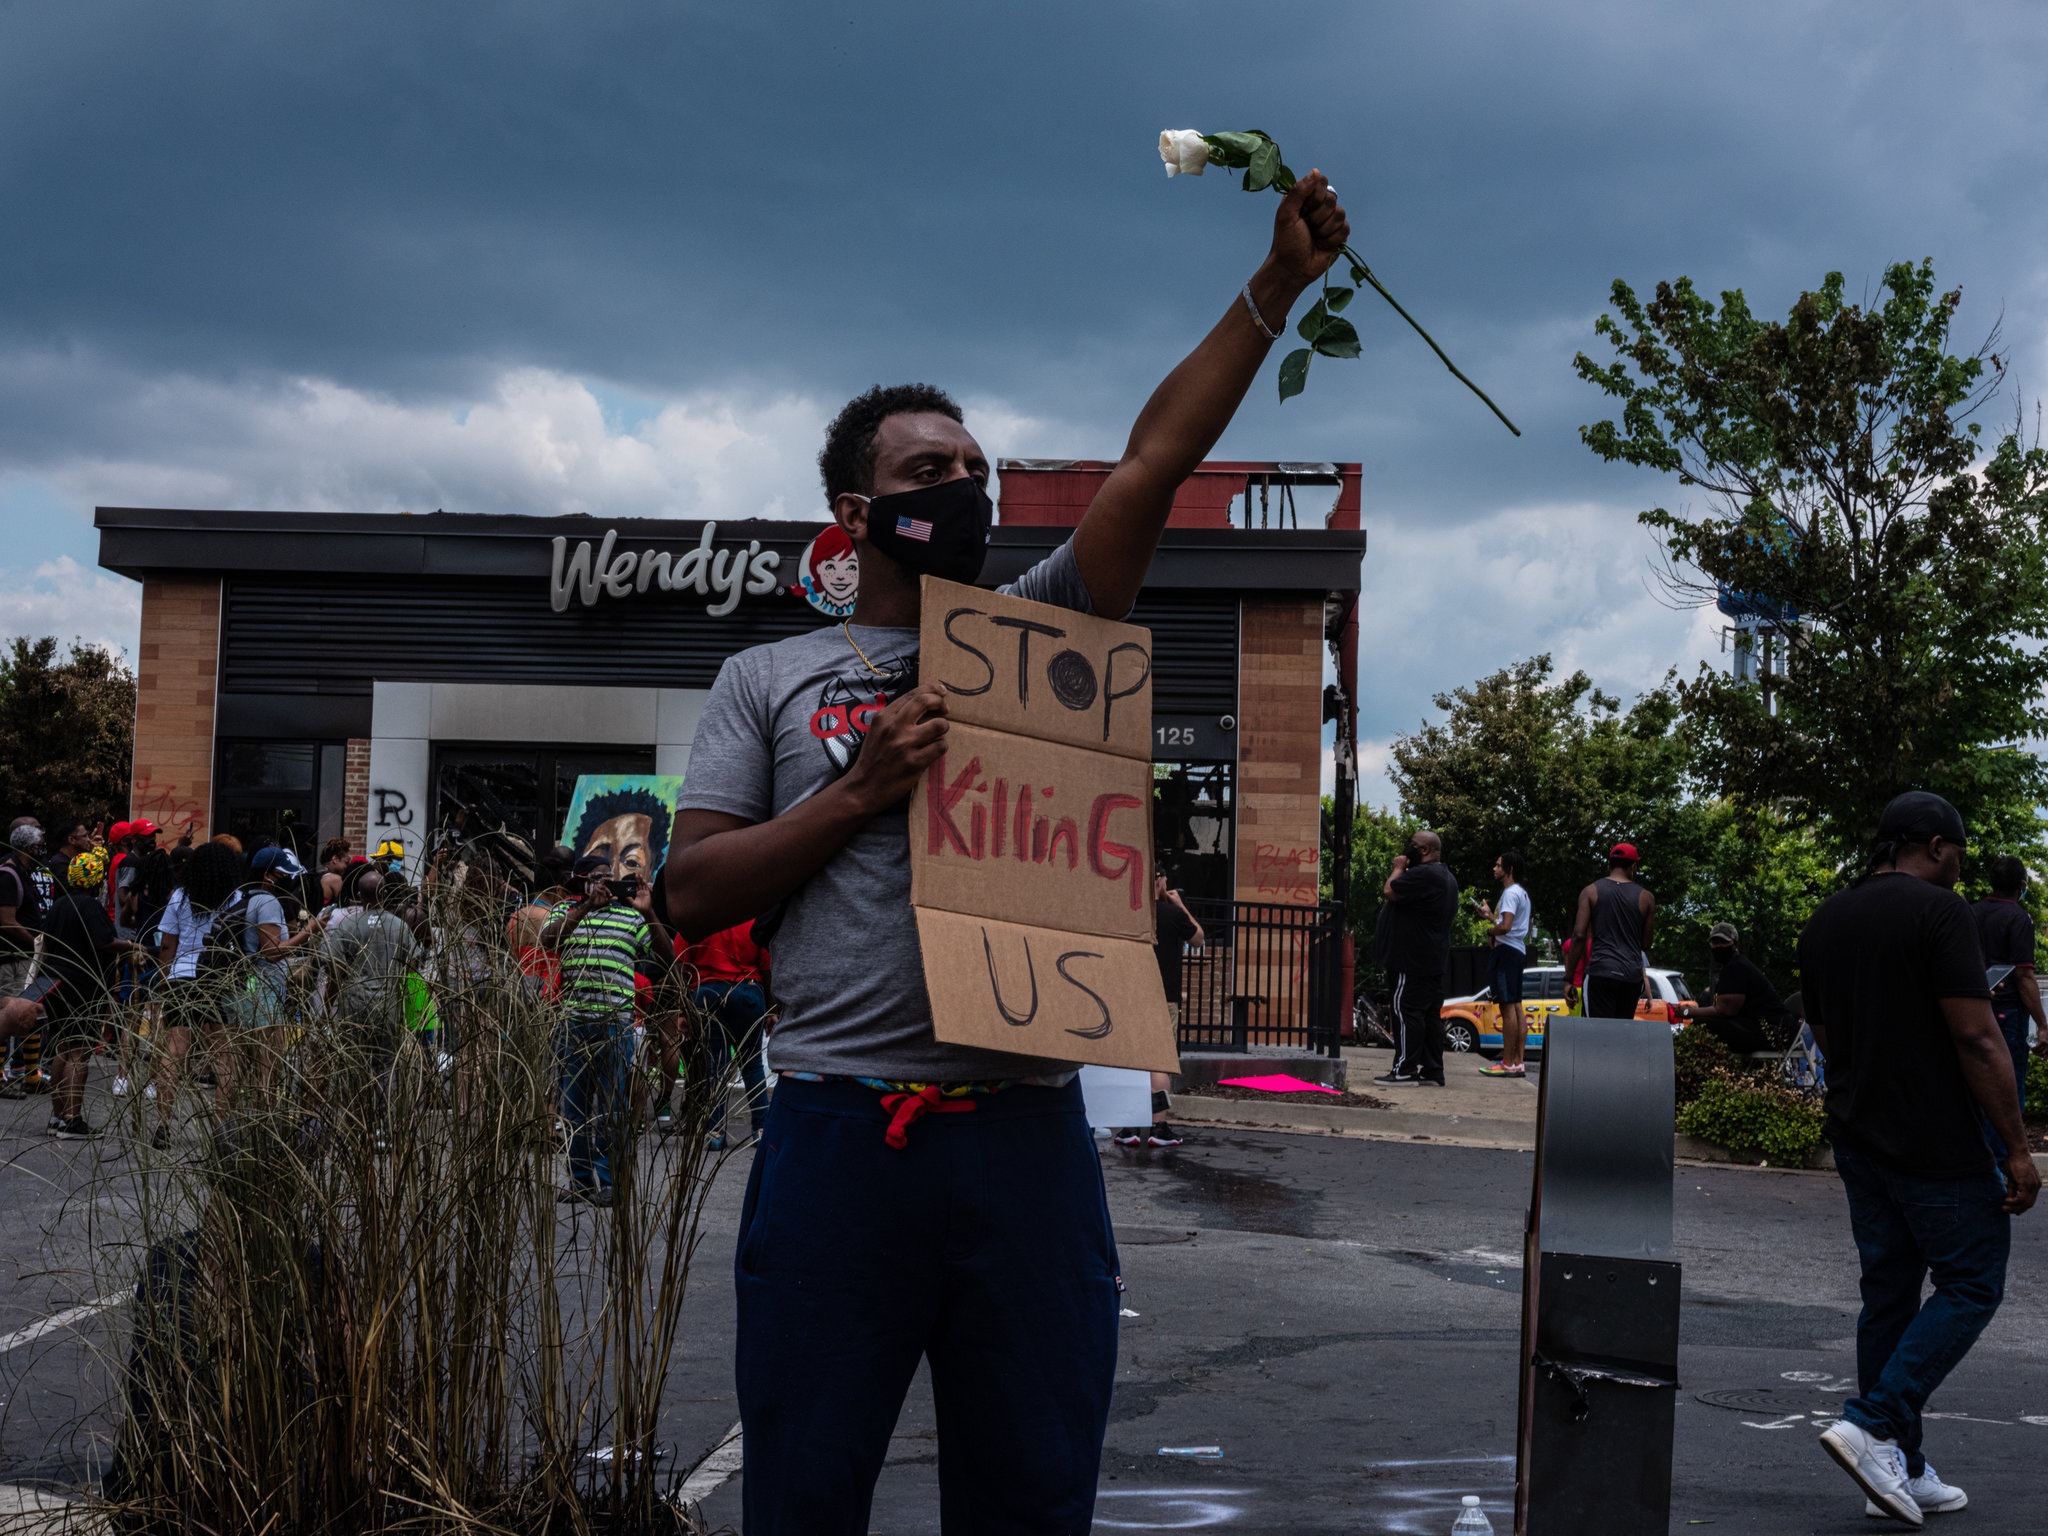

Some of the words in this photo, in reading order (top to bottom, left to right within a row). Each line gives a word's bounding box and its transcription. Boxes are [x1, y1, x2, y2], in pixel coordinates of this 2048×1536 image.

[550, 521, 781, 617] Wendy's
[939, 607, 1151, 742] STOP
[1157, 728, 1195, 746] 125
[981, 926, 1113, 1040] US
